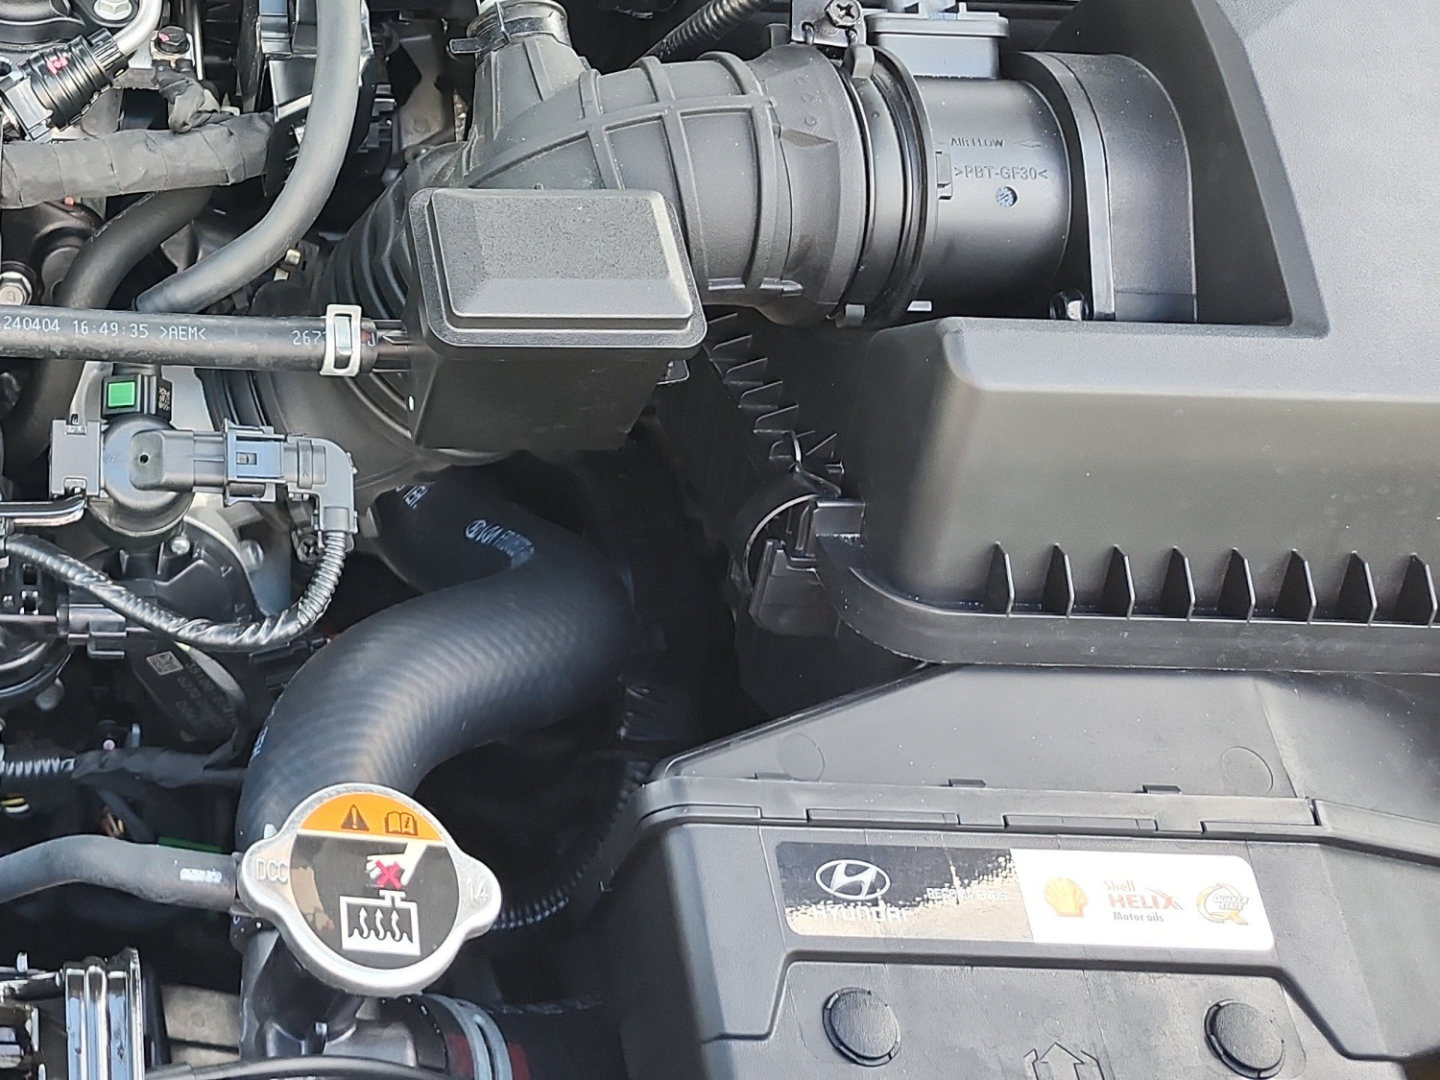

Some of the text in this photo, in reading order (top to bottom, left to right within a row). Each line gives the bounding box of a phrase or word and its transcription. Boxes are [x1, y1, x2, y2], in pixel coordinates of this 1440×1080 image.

[953, 164, 1049, 180] >PBT-GF30<
[3, 316, 61, 334] 240404
[72, 320, 149, 339] 16:49:35
[1103, 878, 1137, 892] Shell
[1107, 892, 1180, 911] HELIX
[1113, 911, 1145, 922] Motor
